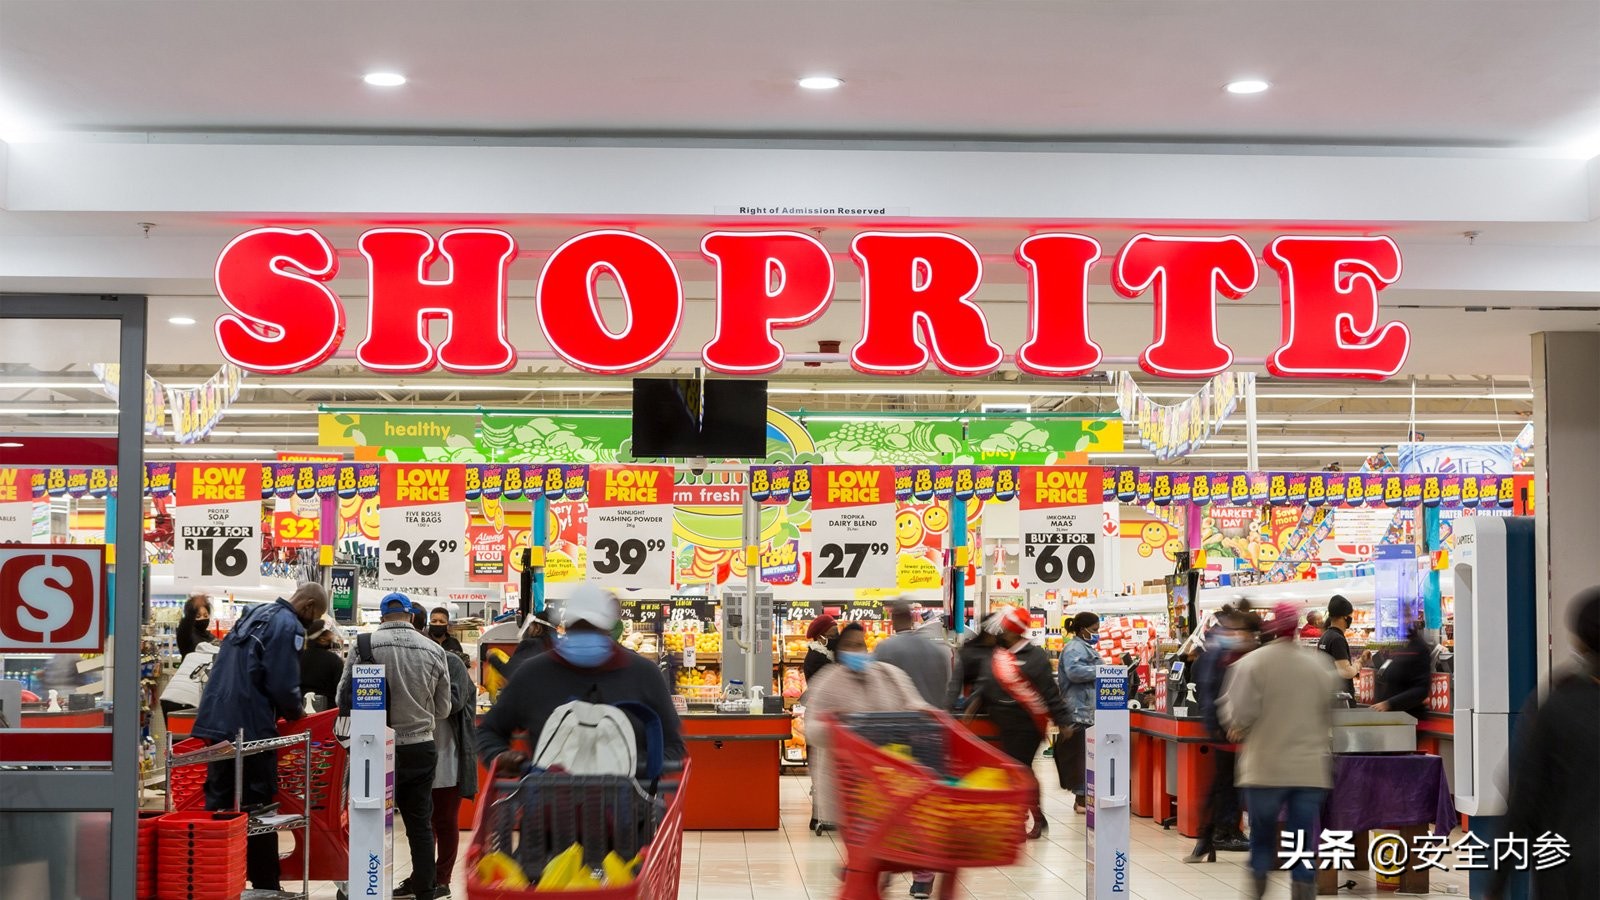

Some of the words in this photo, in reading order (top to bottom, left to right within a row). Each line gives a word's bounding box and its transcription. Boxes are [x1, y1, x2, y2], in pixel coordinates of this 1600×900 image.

[740, 206, 766, 214] Right
[838, 206, 886, 214] Reserved
[214, 226, 1411, 378] SHOPRITE
[385, 421, 450, 440] healthy
[192, 468, 246, 485] LOW
[396, 469, 450, 486] LOW
[605, 470, 658, 487] LOW
[828, 470, 880, 488] LOW
[1036, 472, 1088, 488] LOW
[192, 485, 245, 500] PRICE
[396, 486, 450, 501] PRICE
[605, 487, 657, 502] PRICE
[673, 490, 692, 502] rm
[700, 488, 740, 502] fresh
[828, 488, 880, 502] PRICE
[1036, 489, 1087, 503] PRICE
[555, 505, 572, 515] ery
[1211, 509, 1253, 518] MARKET
[1276, 508, 1297, 517] Save
[1400, 510, 1414, 519] PRE
[1276, 516, 1298, 525] more
[184, 527, 210, 536] BUY
[213, 527, 221, 536] 2
[225, 527, 250, 536] FOR
[1031, 534, 1053, 543] BUY
[1056, 534, 1062, 543] 3
[1067, 534, 1088, 543] FOR
[762, 551, 797, 568] LOW
[356, 667, 380, 675] Protex
[1100, 667, 1123, 675] Protex
[366, 853, 380, 896] Protex
[1112, 850, 1127, 892] Protex
